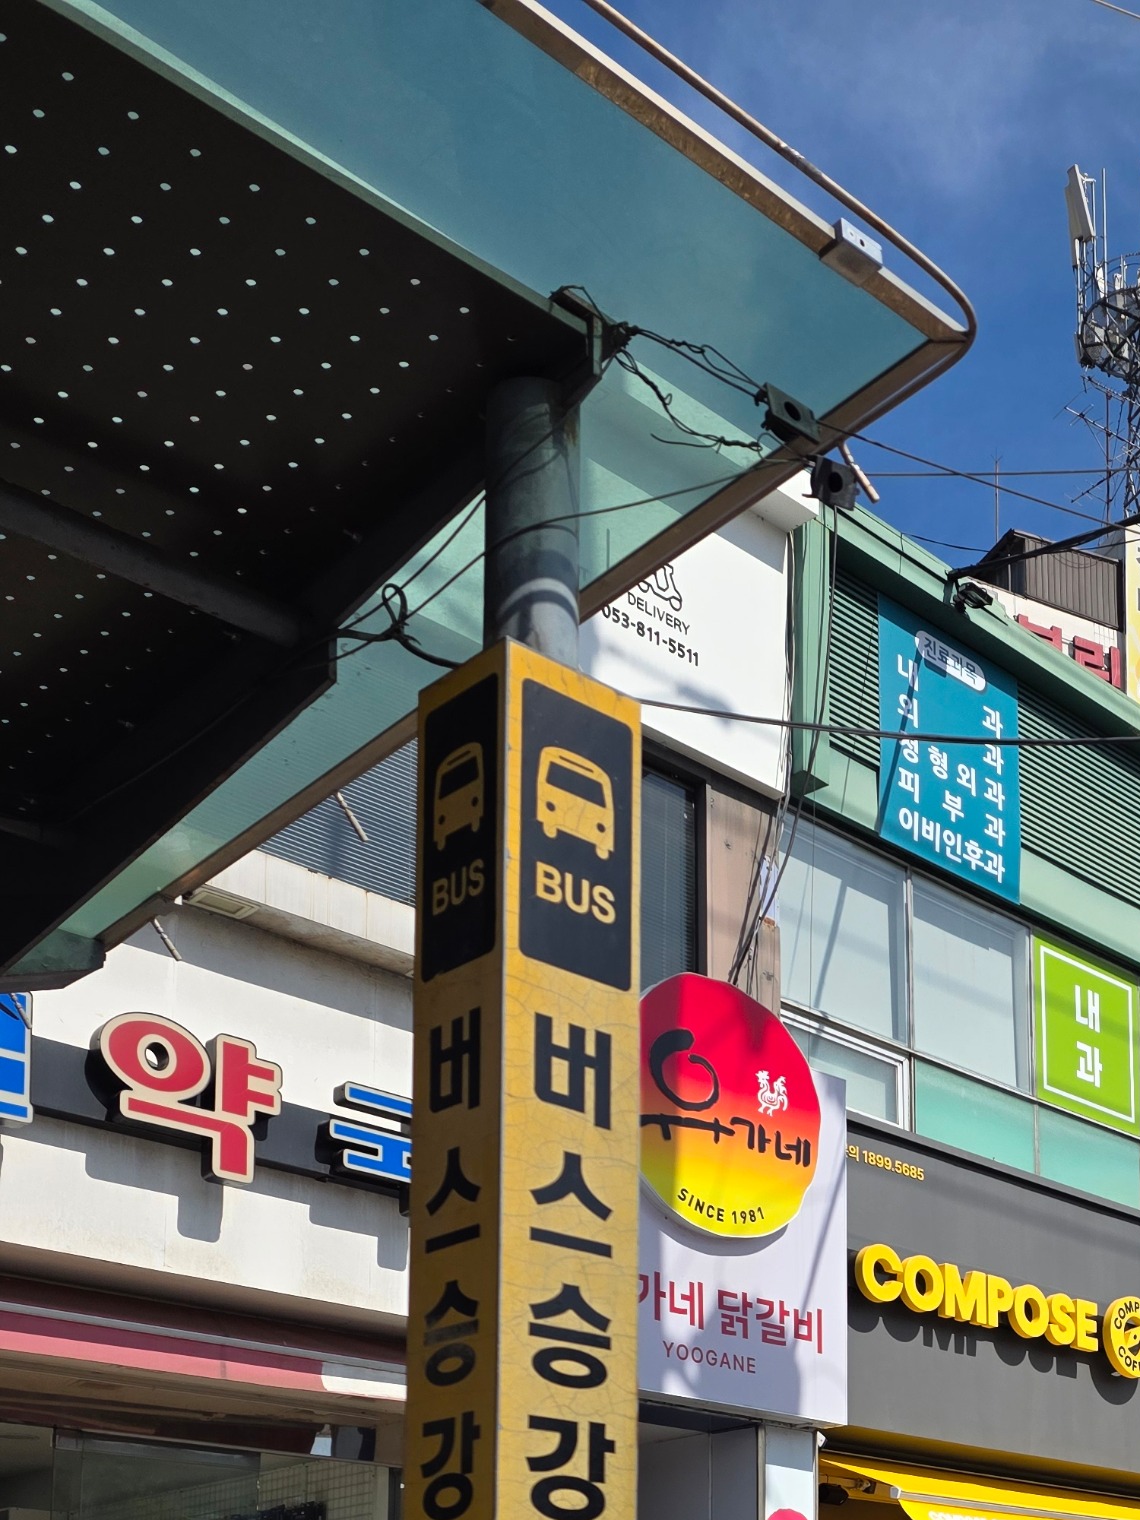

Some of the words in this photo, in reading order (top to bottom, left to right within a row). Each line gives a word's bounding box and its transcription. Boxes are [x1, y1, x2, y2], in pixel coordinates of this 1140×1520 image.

[602, 604, 699, 667] 053-811-5511
[628, 591, 690, 636] DELIVERY
[923, 635, 977, 685] 진료과목
[898, 806, 1006, 884] 이비인후과
[432, 858, 486, 917] BUS
[534, 860, 617, 926] BUS
[1074, 984, 1103, 1089] 내과
[862, 1149, 926, 1181] 1899.5685
[676, 1187, 725, 1223] SINCE
[731, 1205, 766, 1225] 1981
[716, 1287, 824, 1354] 닭갈비
[855, 1243, 1099, 1353] COMPOSE
[661, 1339, 757, 1375] YOOGANE
